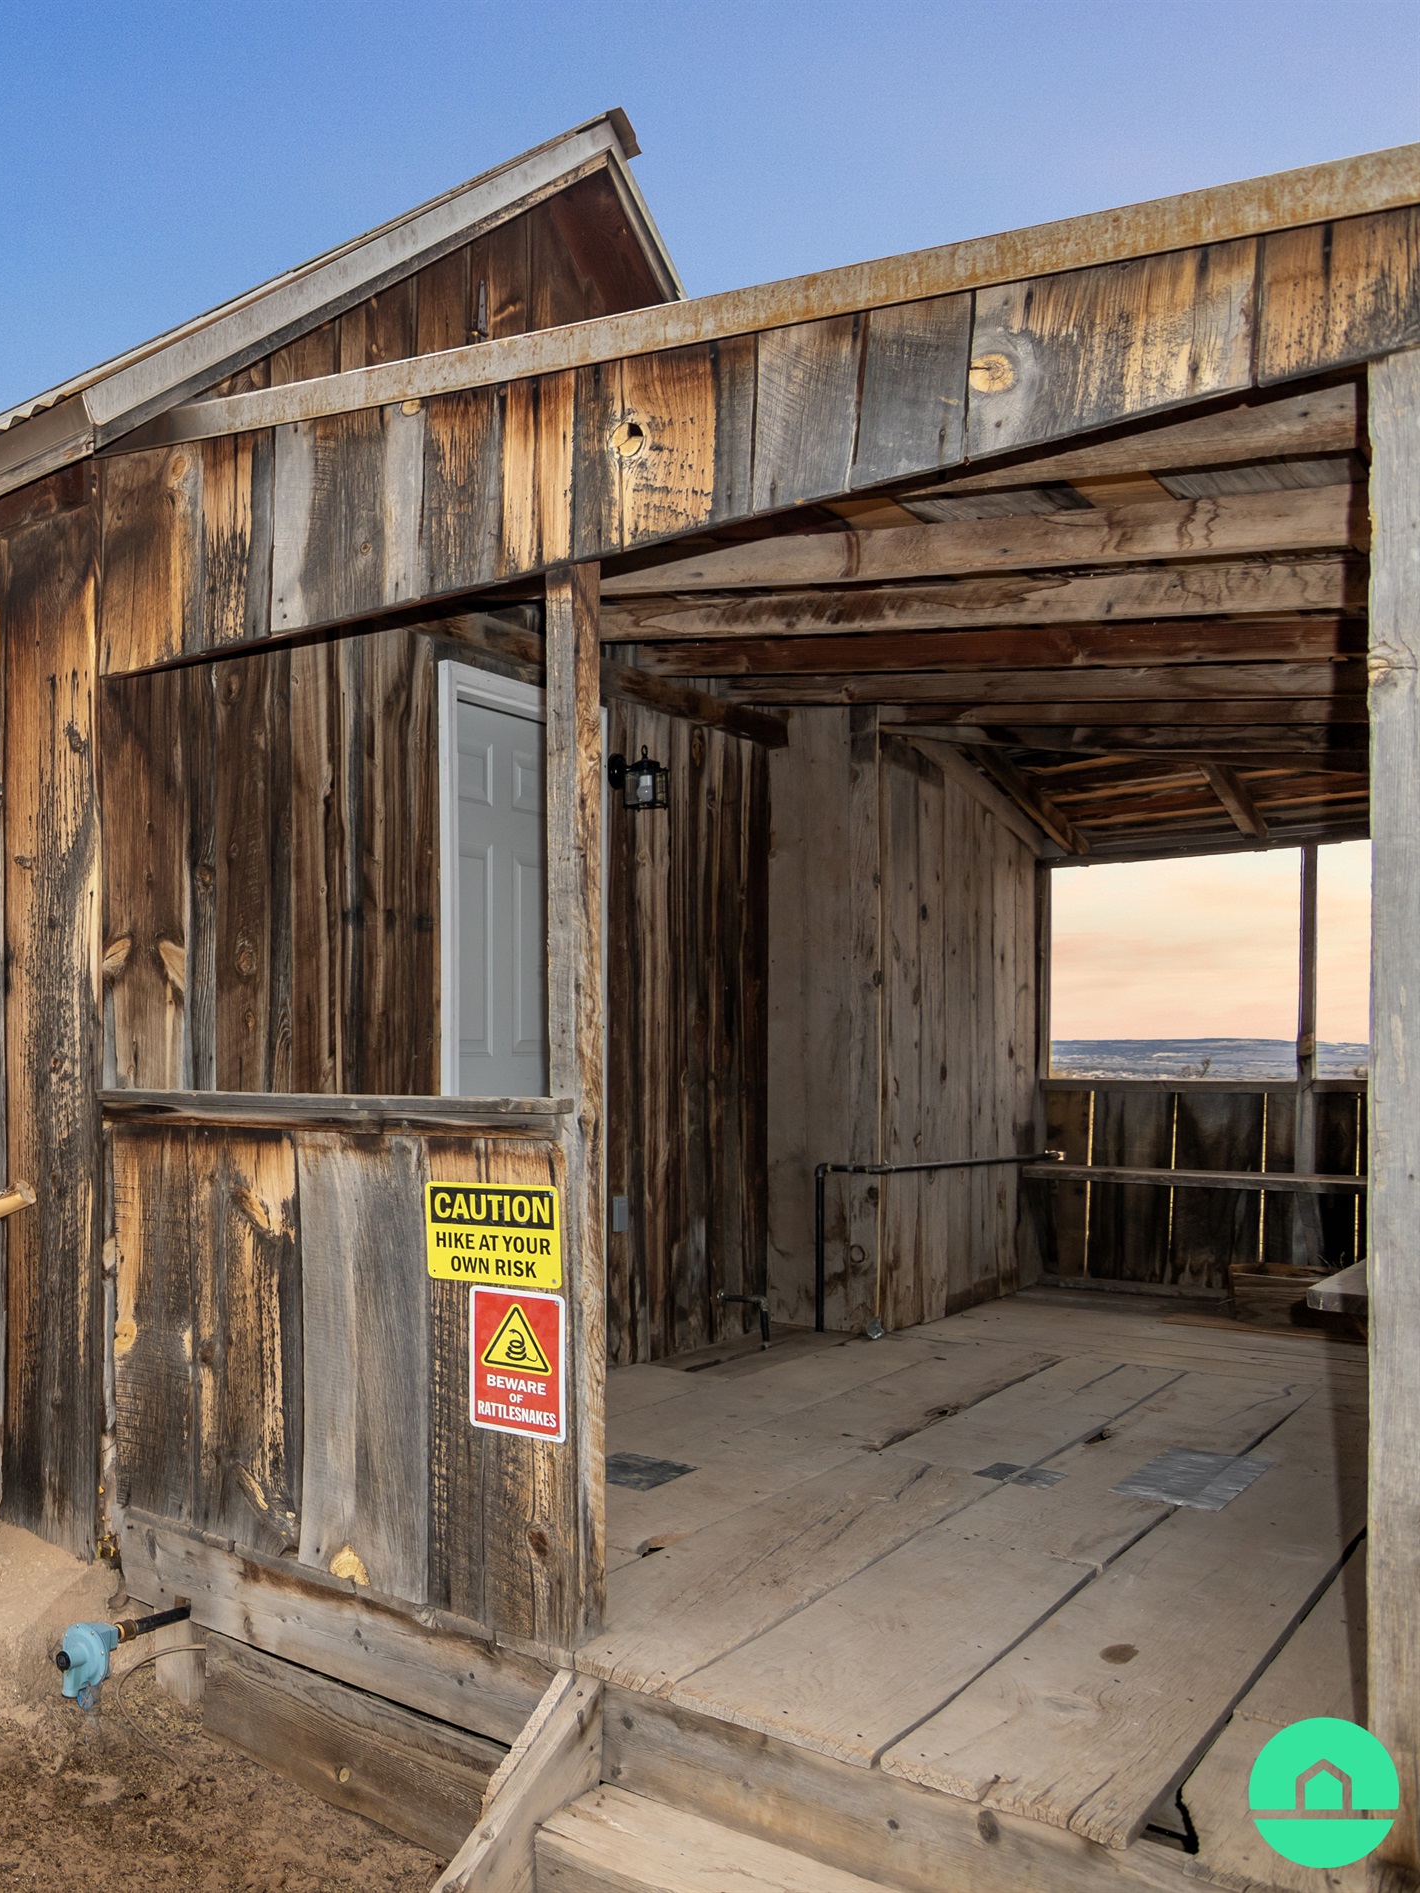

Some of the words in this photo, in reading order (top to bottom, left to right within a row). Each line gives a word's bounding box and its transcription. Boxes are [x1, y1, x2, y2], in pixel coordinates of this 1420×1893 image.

[434, 1192, 550, 1224] CAUTION
[436, 1231, 475, 1250] HIKE
[479, 1234, 499, 1251] AT
[502, 1235, 551, 1255] YOUR
[450, 1255, 489, 1274] OWN
[495, 1259, 537, 1278] RISK
[486, 1373, 547, 1396] BEWARE
[509, 1393, 524, 1403] OF
[477, 1400, 557, 1428] RATTLESNAKES
